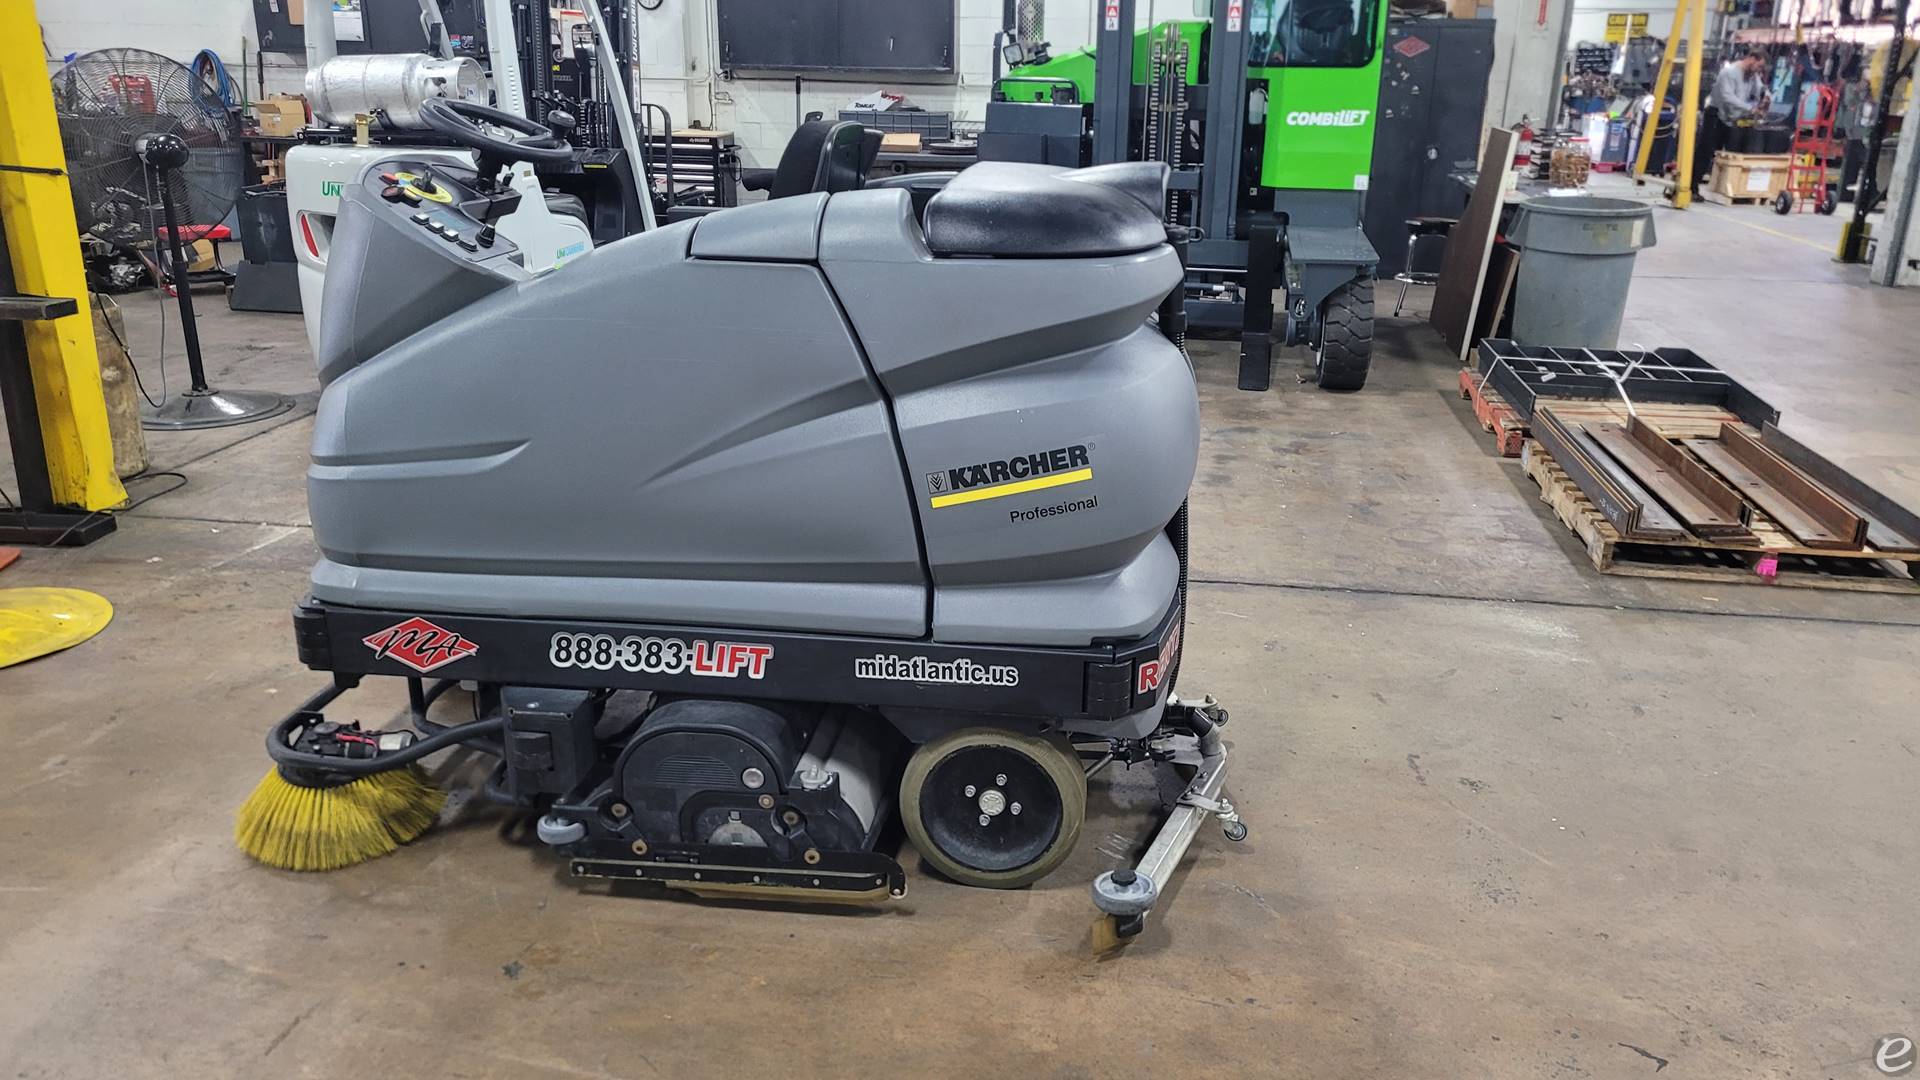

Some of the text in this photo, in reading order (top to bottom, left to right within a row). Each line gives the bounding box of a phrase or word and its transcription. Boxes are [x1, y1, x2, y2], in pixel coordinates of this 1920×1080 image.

[948, 444, 1090, 491] KÄRCHER
[1010, 495, 1098, 523] Professional
[856, 655, 1018, 685] midatlantic.us
